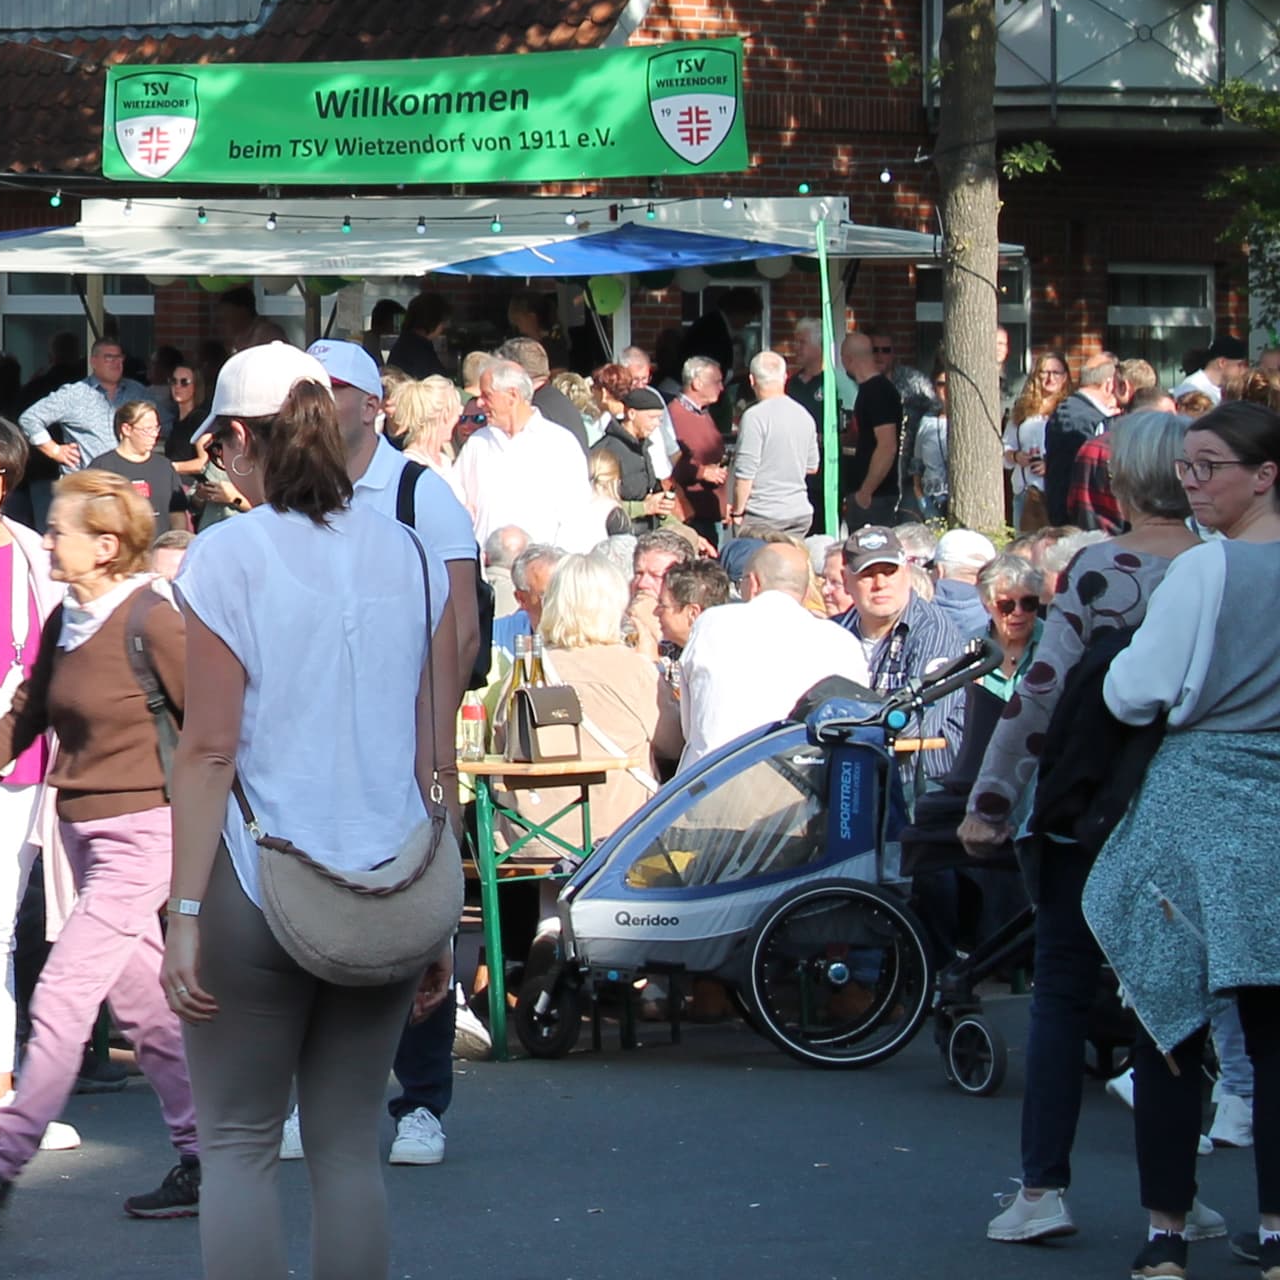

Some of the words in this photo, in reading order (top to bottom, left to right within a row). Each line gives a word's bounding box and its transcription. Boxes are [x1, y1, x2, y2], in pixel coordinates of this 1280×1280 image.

[676, 58, 706, 73] TSV
[143, 81, 169, 96] TSV
[656, 75, 728, 88] WIETZENDORF
[123, 99, 190, 109] WIETZENDORF
[314, 86, 530, 119] Willkommen
[661, 108, 671, 118] 19
[718, 105, 728, 115] 11
[228, 139, 282, 160] beim
[289, 138, 328, 158] TSV
[335, 132, 466, 157] Wietzendorf
[471, 135, 512, 152] von
[519, 129, 570, 150] 1911
[577, 127, 616, 148] e.V.
[615, 911, 680, 927] Qeridoo
